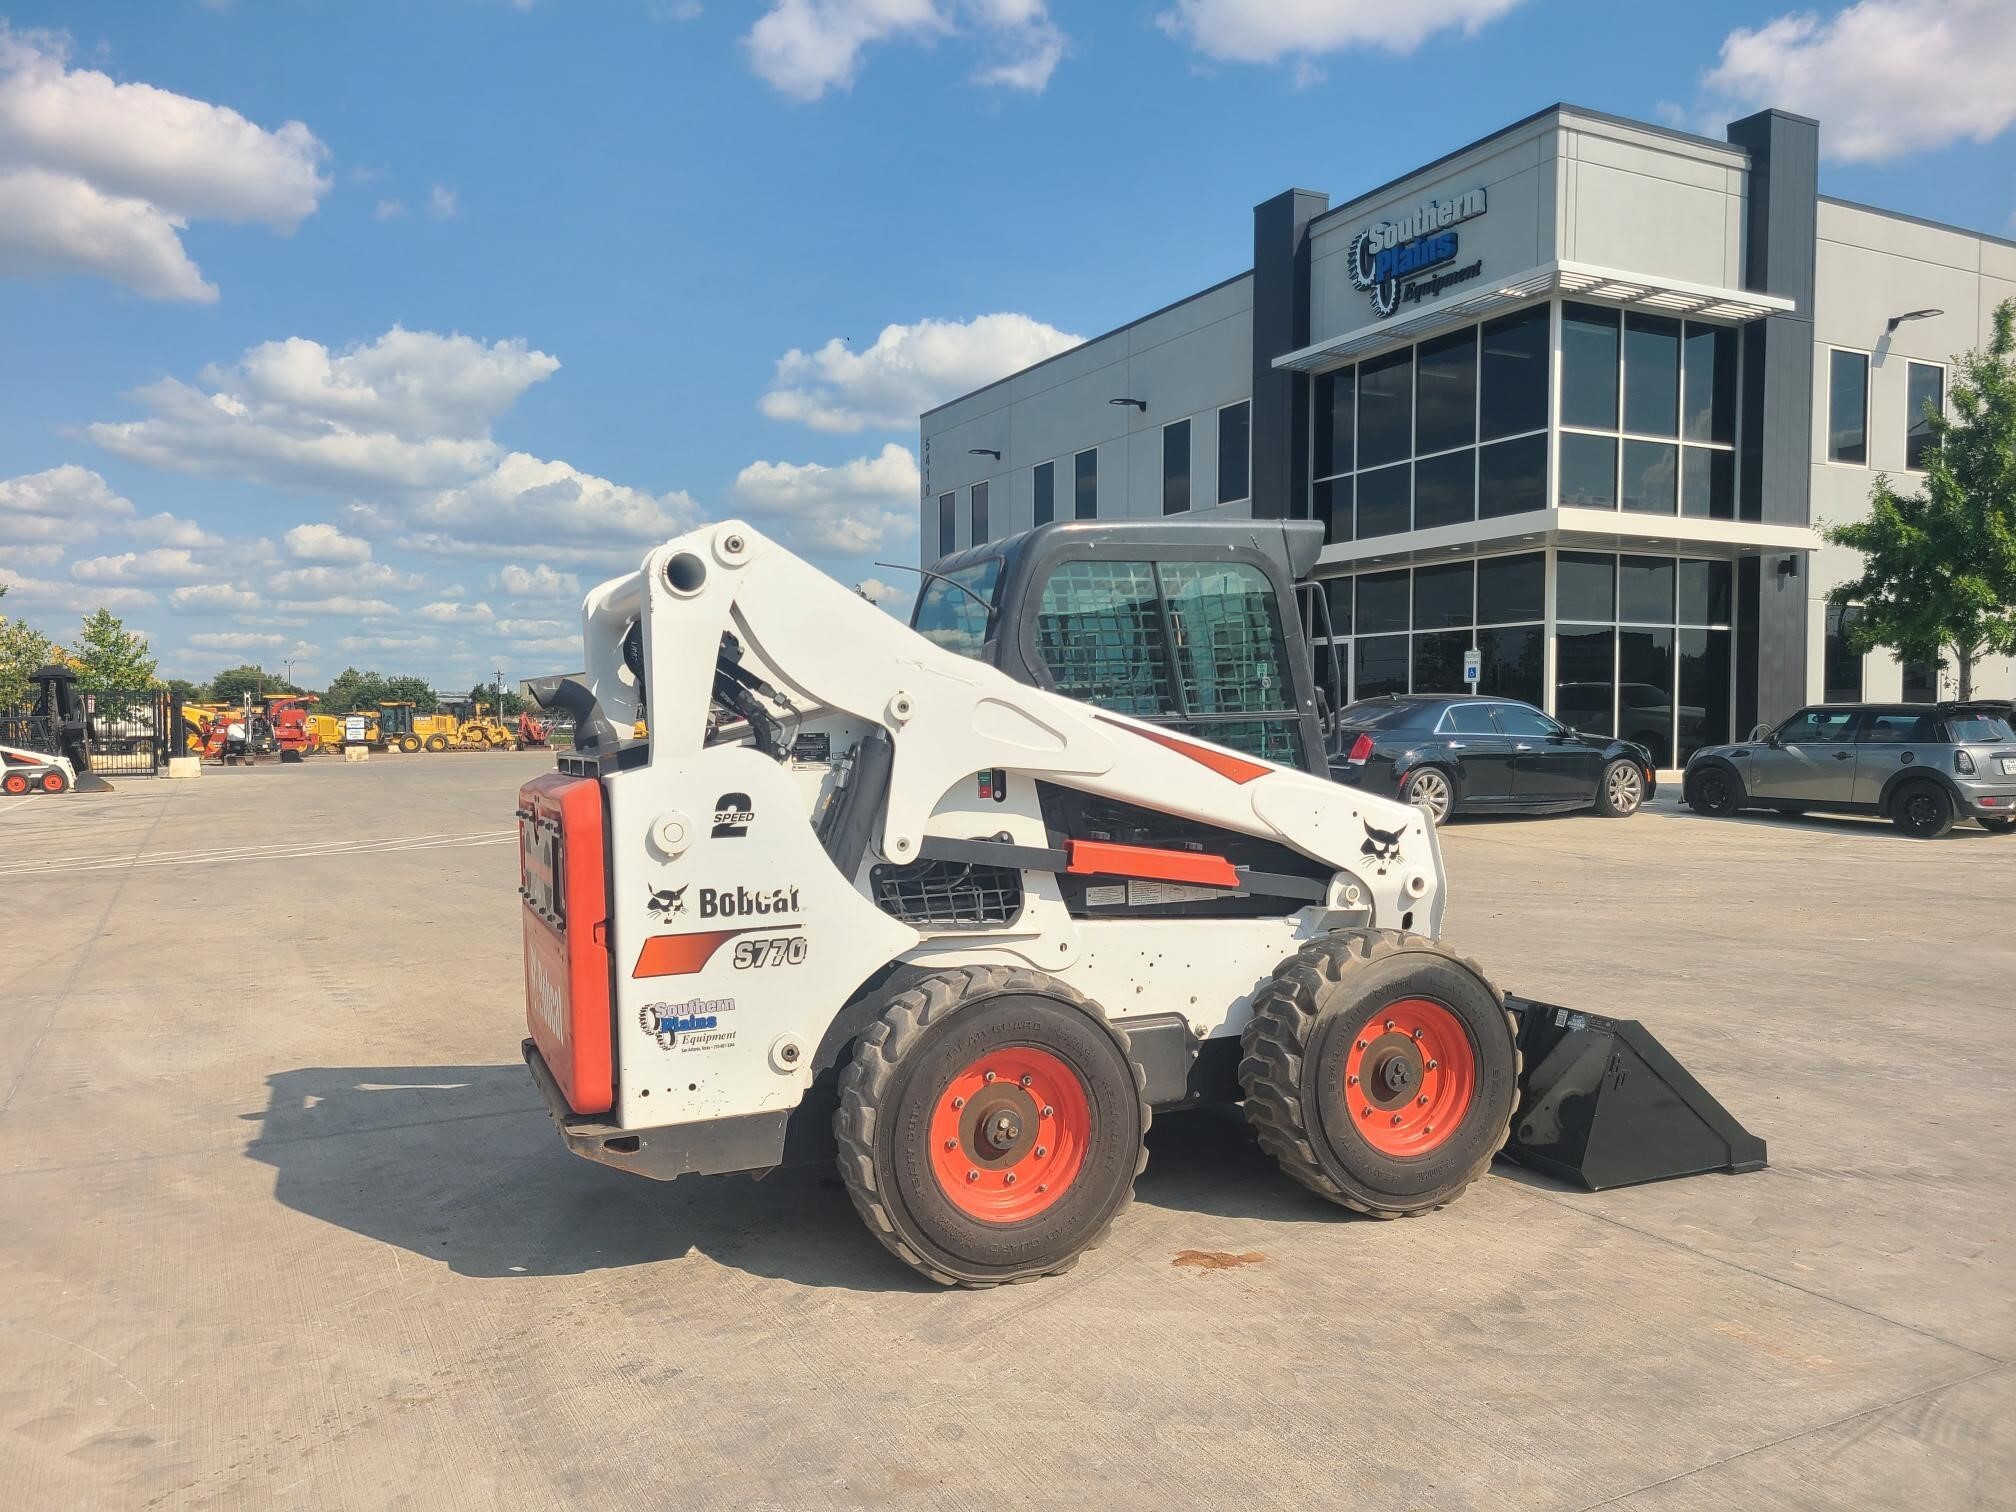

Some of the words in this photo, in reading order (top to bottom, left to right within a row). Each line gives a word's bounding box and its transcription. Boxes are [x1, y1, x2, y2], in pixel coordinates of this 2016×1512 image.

[1368, 187, 1487, 255] Southern
[1375, 232, 1458, 285] Plains
[1402, 259, 1482, 303] Equipment
[711, 792, 752, 839] 2
[713, 812, 755, 823] SPEED
[699, 885, 800, 918] Bobcat
[733, 937, 807, 970] S770
[654, 998, 736, 1018] Southern
[660, 1014, 717, 1034] Plains
[681, 1030, 737, 1046] Equipment
